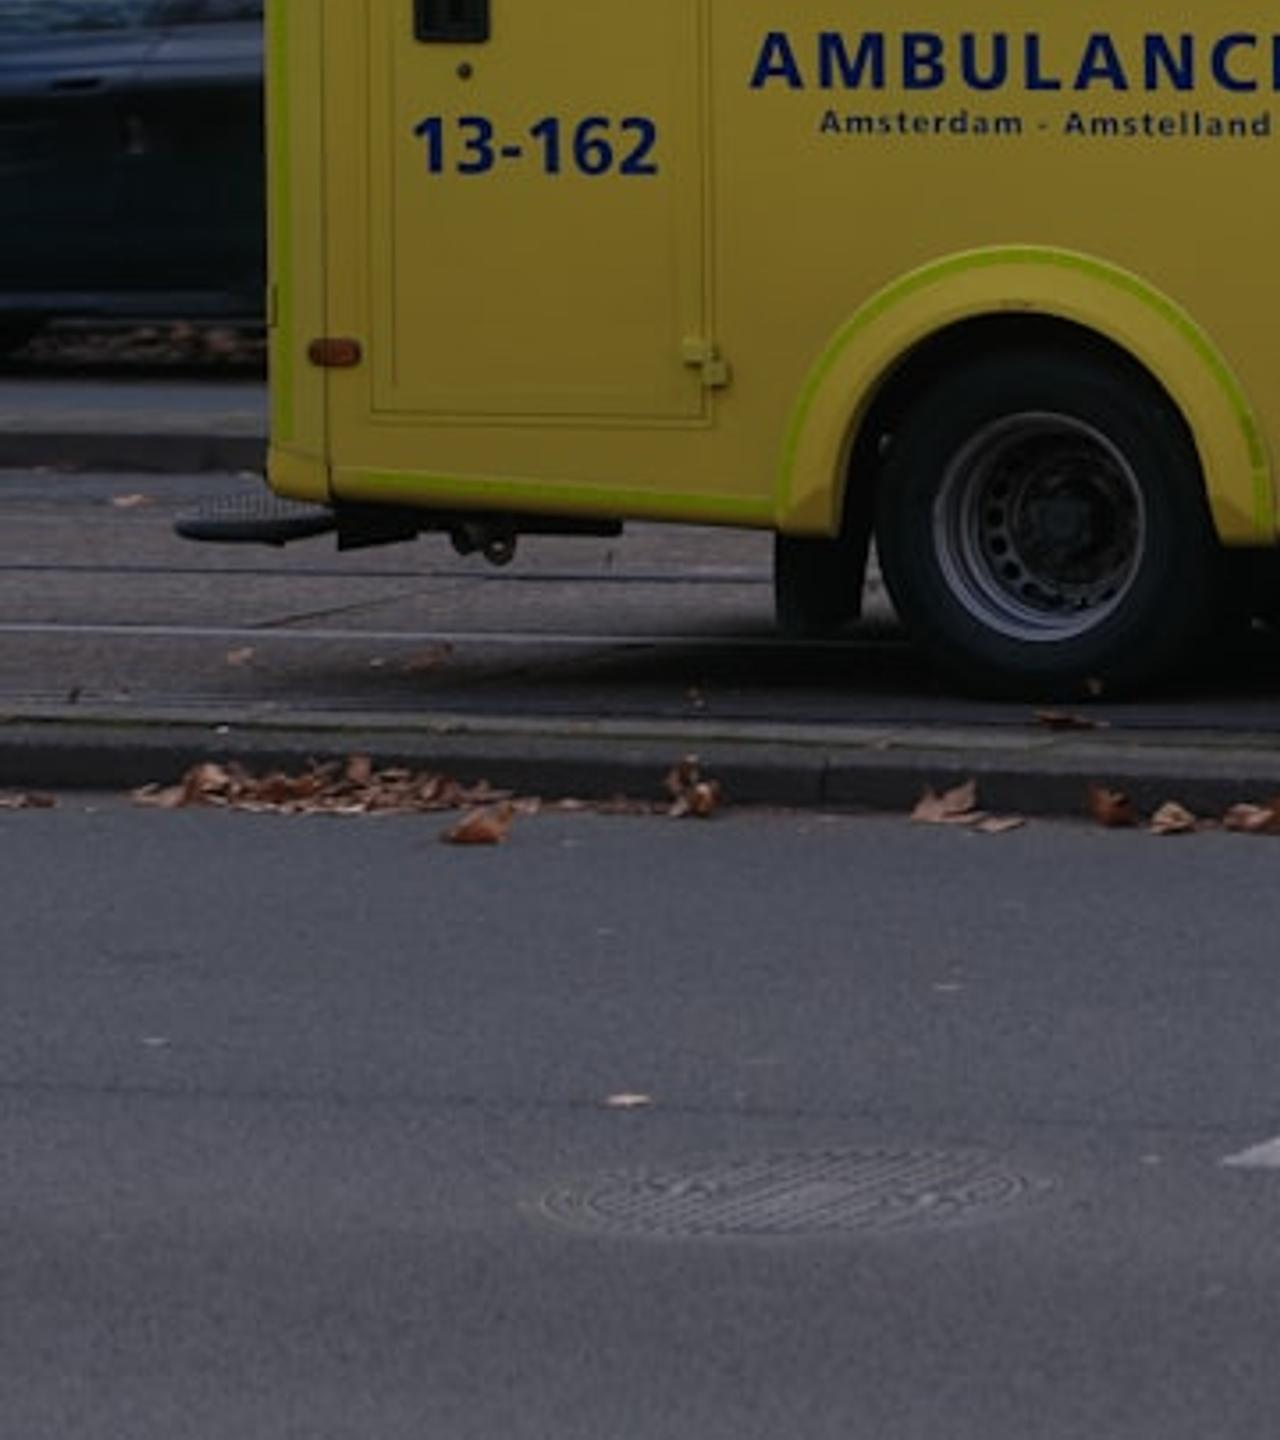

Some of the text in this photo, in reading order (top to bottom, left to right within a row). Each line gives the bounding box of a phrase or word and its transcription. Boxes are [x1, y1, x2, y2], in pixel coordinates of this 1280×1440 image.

[819, 109, 1023, 136] Amsterdam
[1063, 111, 1272, 138] Amstelland
[413, 116, 659, 176] 13-162
